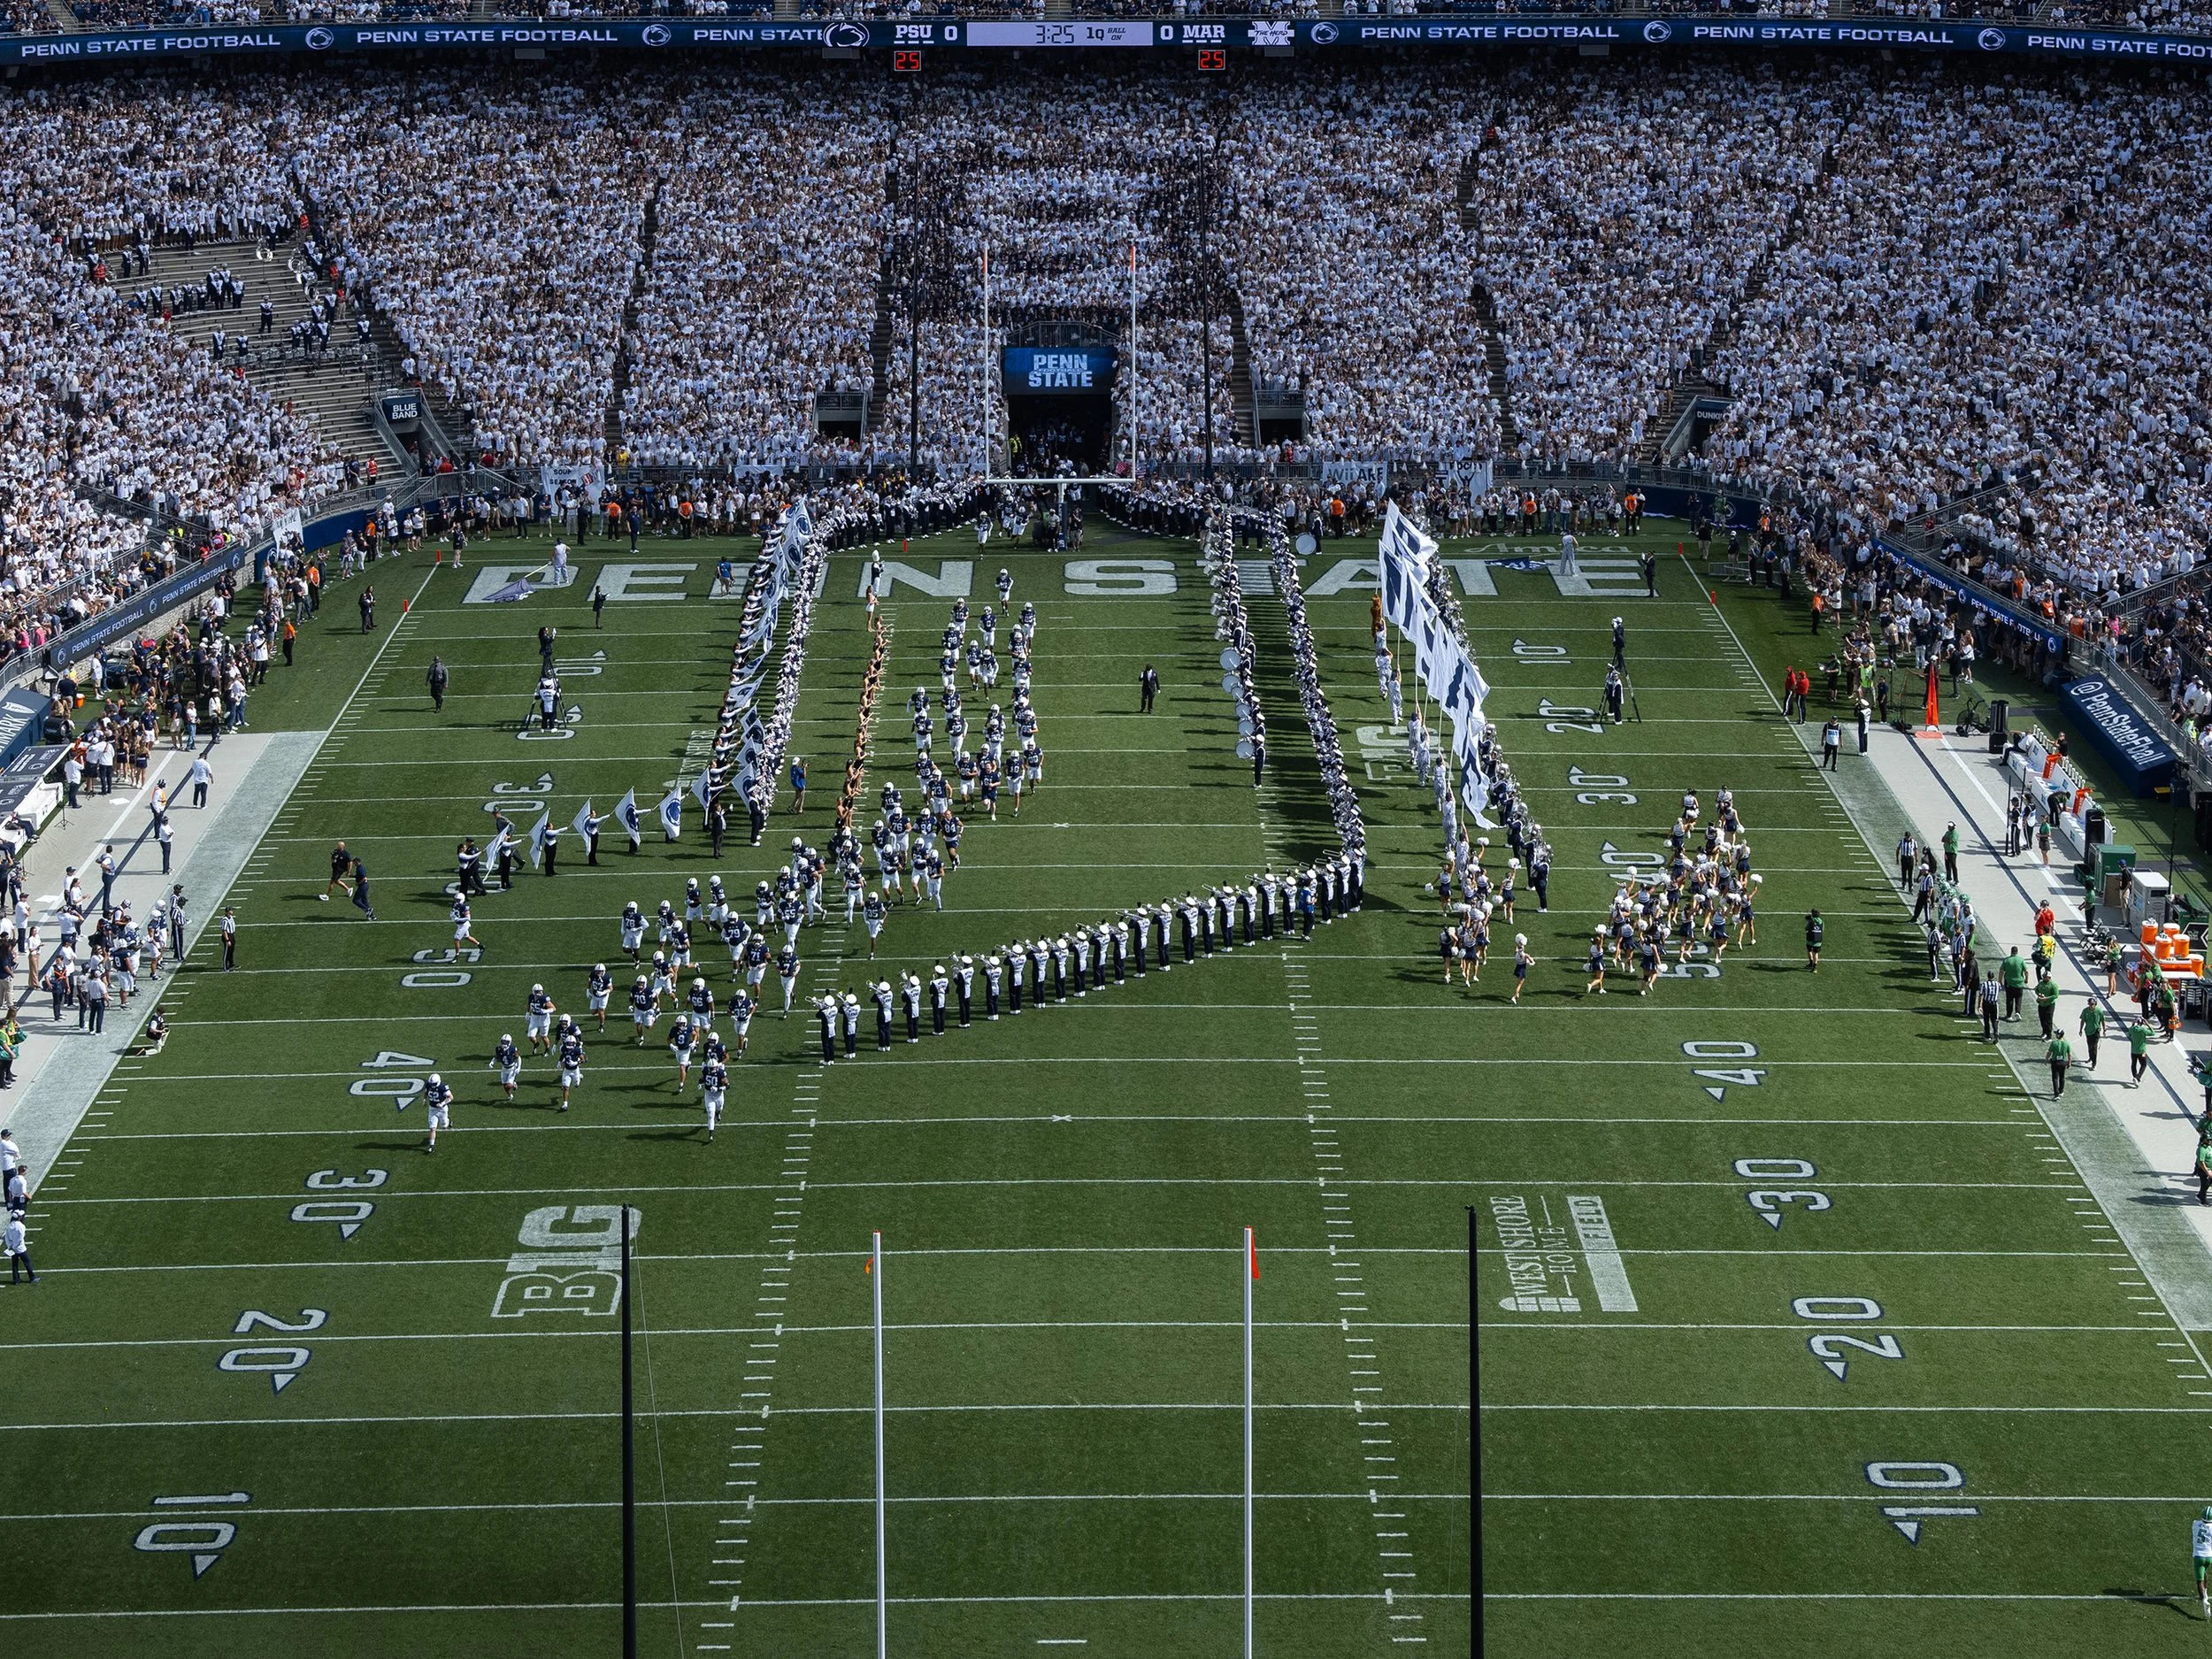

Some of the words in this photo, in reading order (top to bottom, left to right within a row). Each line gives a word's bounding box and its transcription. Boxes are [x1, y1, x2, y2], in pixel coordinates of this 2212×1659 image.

[357, 30, 419, 44] PENN
[425, 29, 495, 43] STATE
[502, 28, 618, 42] FOOTBALL
[693, 28, 754, 42] PENN
[895, 24, 933, 39] PSU
[943, 26, 958, 42] 0
[1035, 24, 1075, 44] 3:25
[1086, 27, 1105, 42] 1Q
[1159, 26, 1174, 41] 0
[1182, 24, 1225, 39] MAR
[1361, 27, 1421, 39] PENN
[1427, 26, 1497, 39] STATE
[1503, 26, 1620, 39] FOOTBALL
[1693, 26, 1753, 39] PENN
[1760, 27, 1832, 41] STATE
[1838, 28, 1954, 44] FOOTBALL
[21, 43, 81, 58] PENN
[86, 38, 157, 53] STATE
[164, 33, 281, 50] FOOTBALL
[2027, 35, 2085, 50] PENN
[2092, 38, 2159, 55] STATE
[896, 52, 920, 70] 25
[1199, 50, 1225, 69] 25
[1033, 354, 1088, 370] PENN
[1028, 371, 1094, 388] STATE
[392, 410, 418, 420] BAND
[393, 403, 417, 412] BLUE
[1328, 467, 1355, 481] Wii
[1356, 466, 1384, 481] ARE
[162, 589, 180, 604] PENN
[179, 578, 199, 595] STATE
[197, 563, 228, 584] FOOTBALL
[72, 640, 90, 655] PENN
[90, 629, 111, 645] STATE
[111, 609, 144, 633] FOOTBALL
[1989, 607, 2008, 625] STATE
[2008, 618, 2040, 641] FOTBLL
[1512, 646, 1572, 664] 10
[1538, 706, 1605, 733] 20
[1567, 774, 1640, 805] 30
[945, 824, 956, 833] 84
[780, 883, 789, 892] 54
[784, 909, 795, 918] 55
[868, 909, 878, 918] 35
[728, 929, 740, 938] 79
[114, 956, 121, 967] 8
[750, 951, 760, 961] 71
[401, 947, 485, 988] 50
[530, 1002, 540, 1012] 65
[634, 995, 646, 1004] 70
[734, 1009, 746, 1018] 32
[678, 1034, 685, 1044] 9
[1681, 1040, 1768, 1087] 40
[348, 1049, 437, 1097] 40
[706, 1075, 718, 1086] 50
[428, 1091, 439, 1102] 52
[1732, 1157, 1833, 1211] 30
[288, 1168, 390, 1224] 30
[1490, 1194, 1537, 1248] SHORE
[1573, 1200, 1609, 1240] FIELD
[1538, 1226, 1577, 1273] HOME
[1504, 1253, 1548, 1297] WEST
[1792, 1295, 1905, 1360] 20
[217, 1308, 330, 1372] 20
[1864, 1461, 1981, 1517] 10
[133, 1491, 253, 1552] 10
